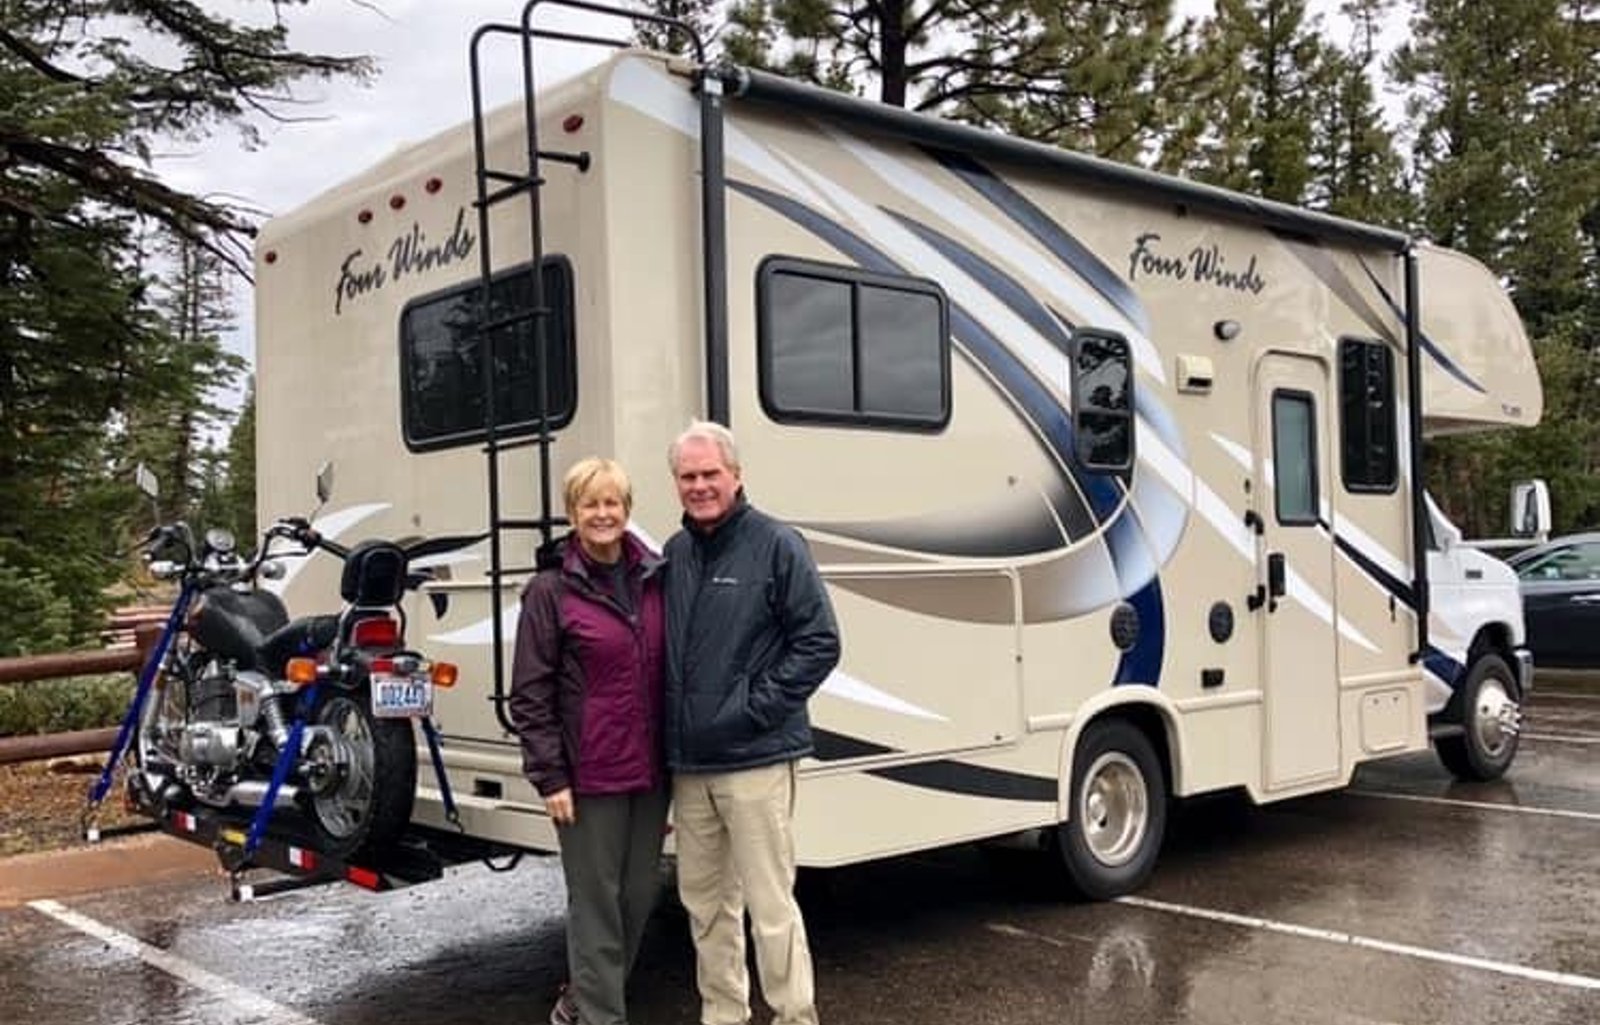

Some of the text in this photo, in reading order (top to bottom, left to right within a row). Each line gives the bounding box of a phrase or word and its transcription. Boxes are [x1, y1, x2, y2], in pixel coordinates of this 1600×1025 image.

[335, 206, 476, 316] Four Winds
[1129, 232, 1266, 295] Four Winds
